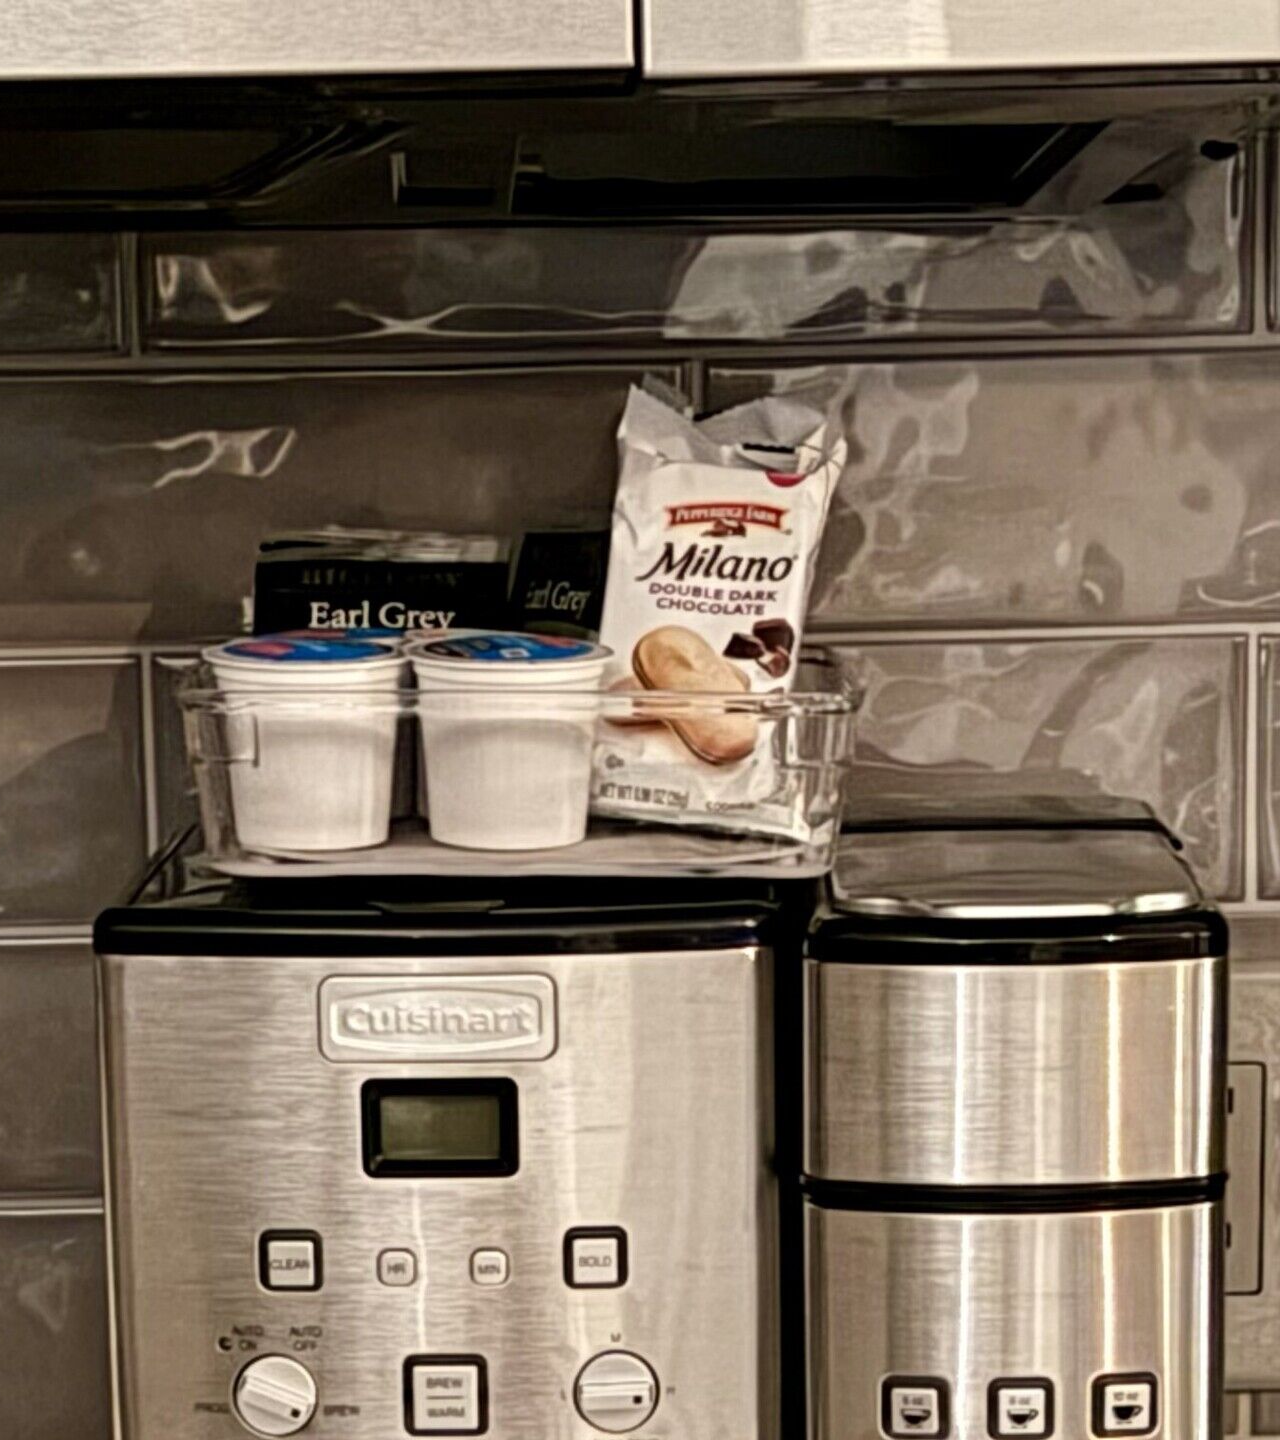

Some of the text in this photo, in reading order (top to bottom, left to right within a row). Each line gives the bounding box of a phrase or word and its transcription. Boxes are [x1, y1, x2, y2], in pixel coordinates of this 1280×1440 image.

[635, 541, 794, 582] Milano
[648, 583, 778, 602] DOUBLE DARK
[655, 597, 765, 616] CHOCOLATE
[309, 601, 456, 630] Earl Grey
[341, 1001, 536, 1036] Cuisinart
